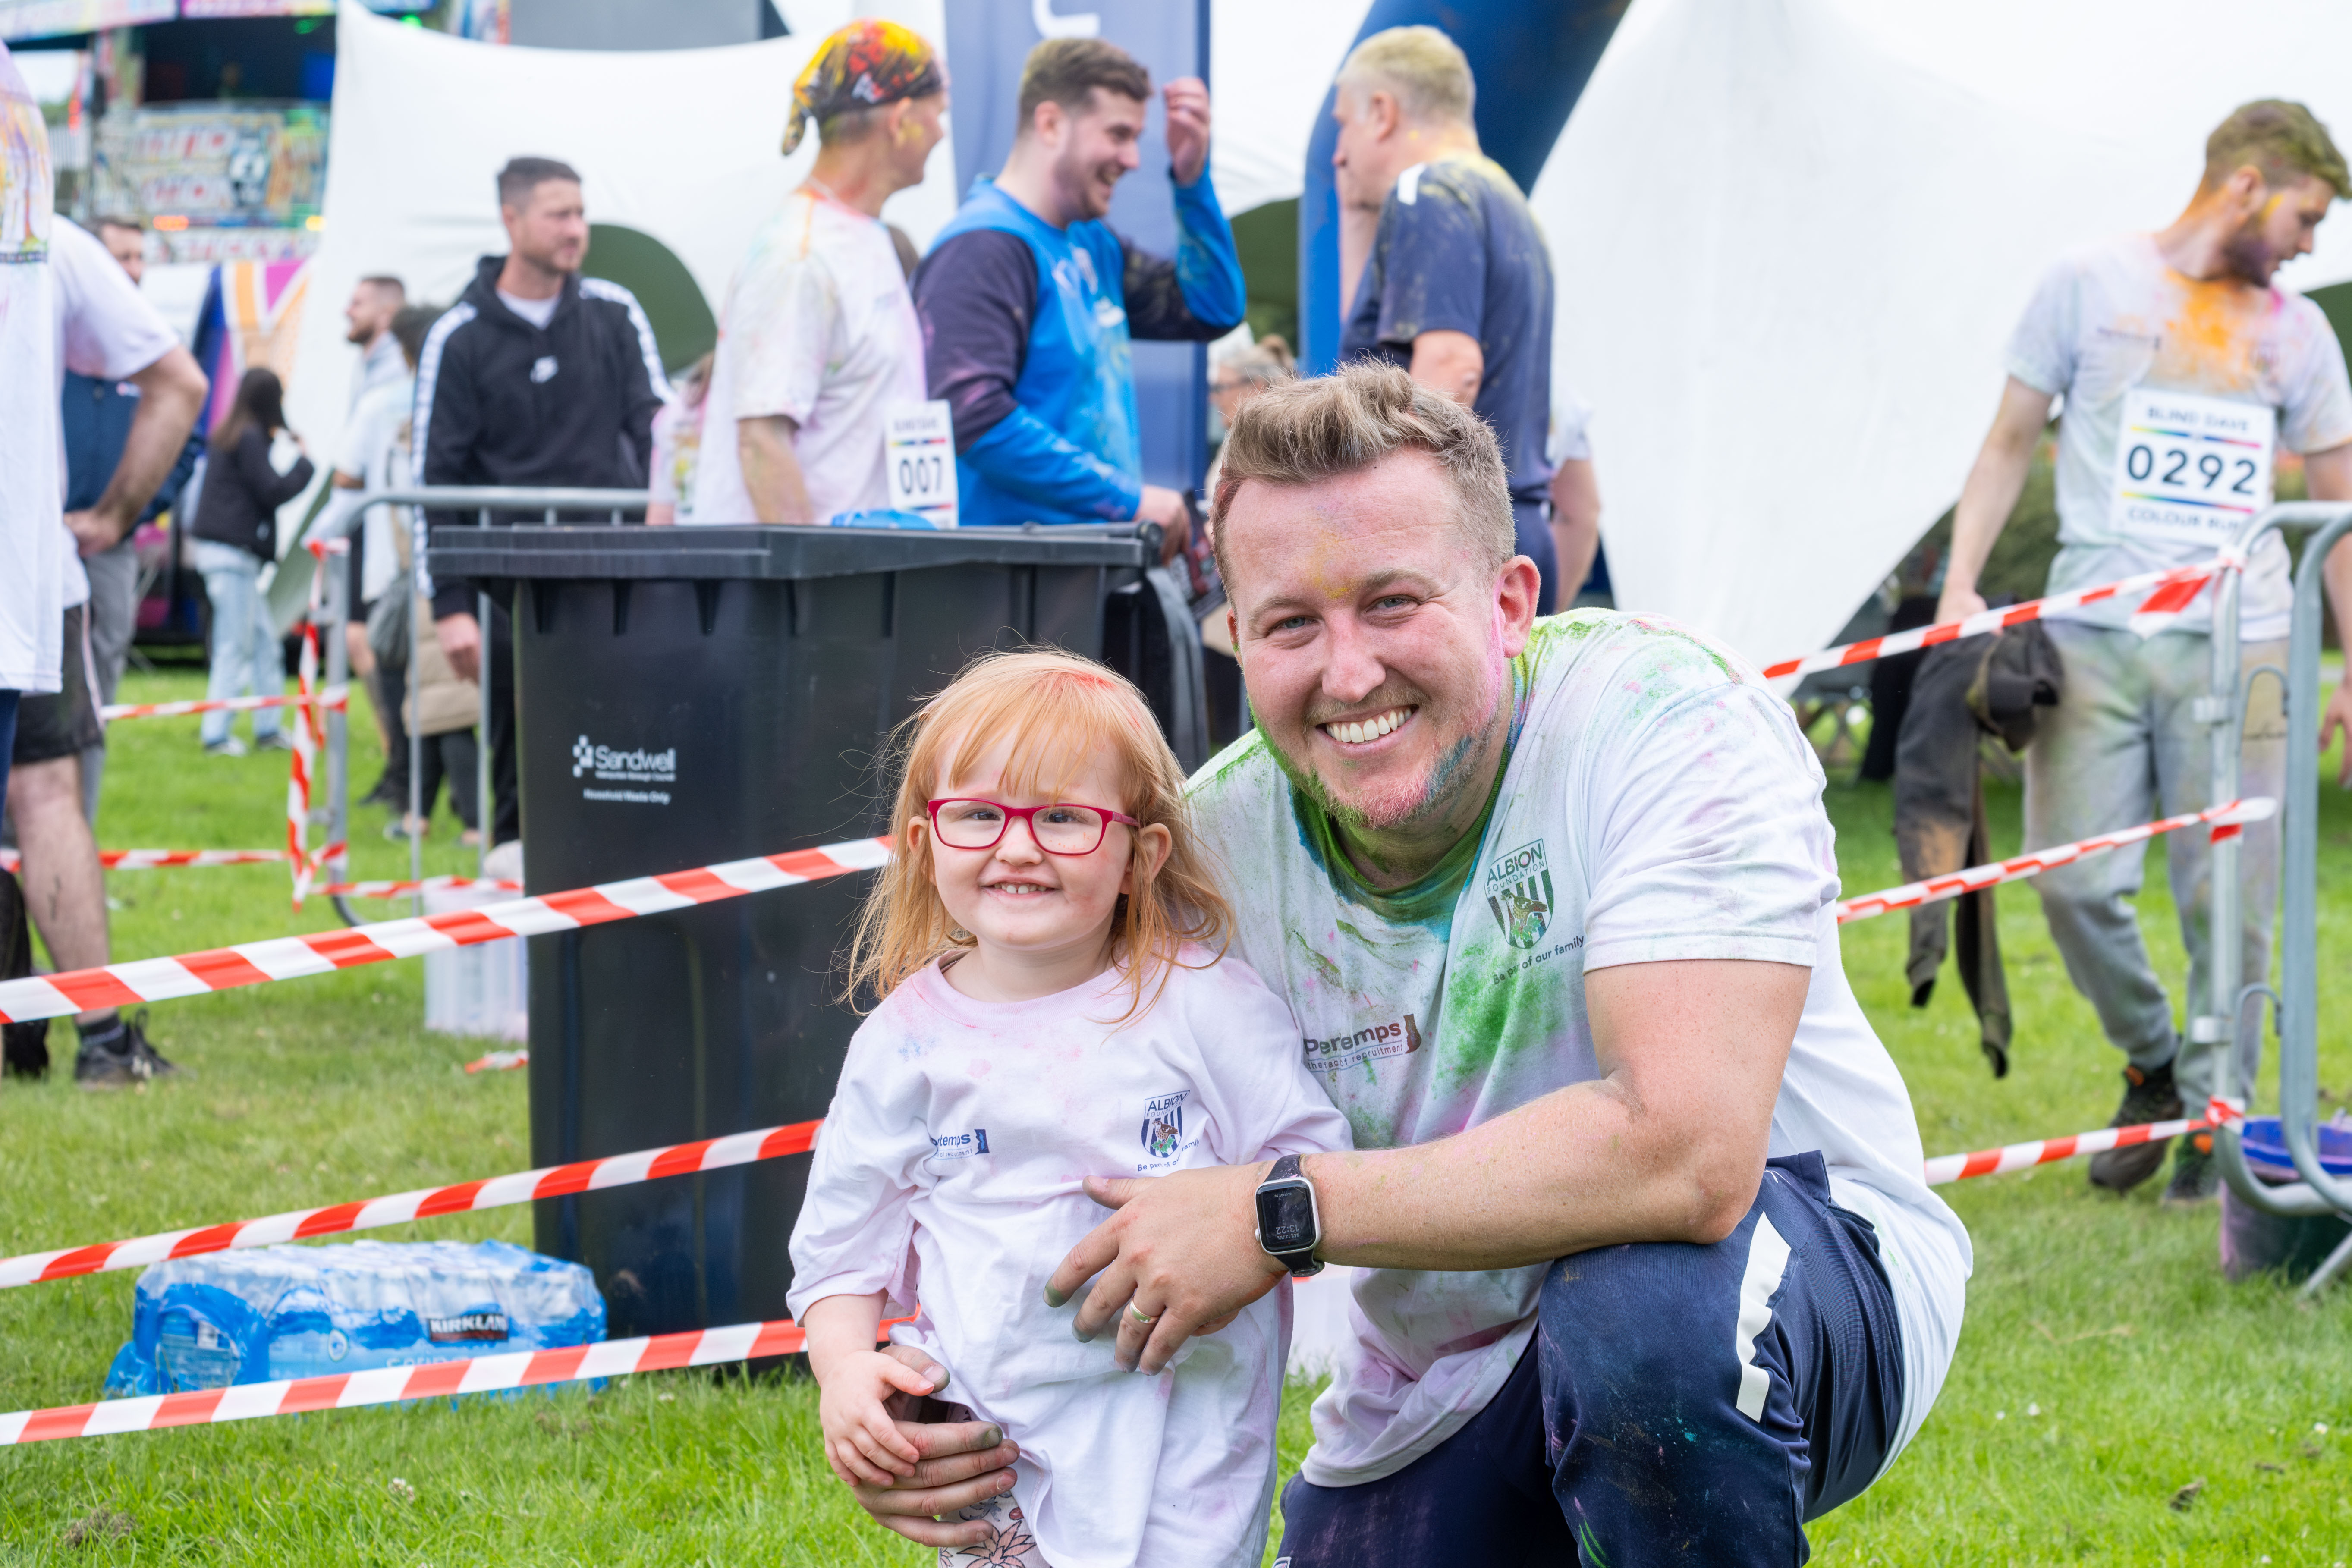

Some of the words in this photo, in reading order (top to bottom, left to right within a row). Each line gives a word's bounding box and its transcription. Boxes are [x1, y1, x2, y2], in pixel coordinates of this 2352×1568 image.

[899, 456, 941, 494] 007
[2127, 444, 2256, 495] 0292
[595, 745, 676, 772] Sandwell
[1487, 843, 1543, 886] ALBION
[1487, 860, 1544, 894] FOUNDATION
[1493, 974, 1506, 985] Be
[1507, 963, 1520, 977] par
[1522, 955, 1532, 969] of
[1535, 950, 1552, 963] our
[1555, 936, 1584, 955] family
[1352, 1044, 1402, 1062] recruitment
[1148, 1093, 1187, 1112] ALBION
[1276, 1224, 1299, 1235] 13:22
